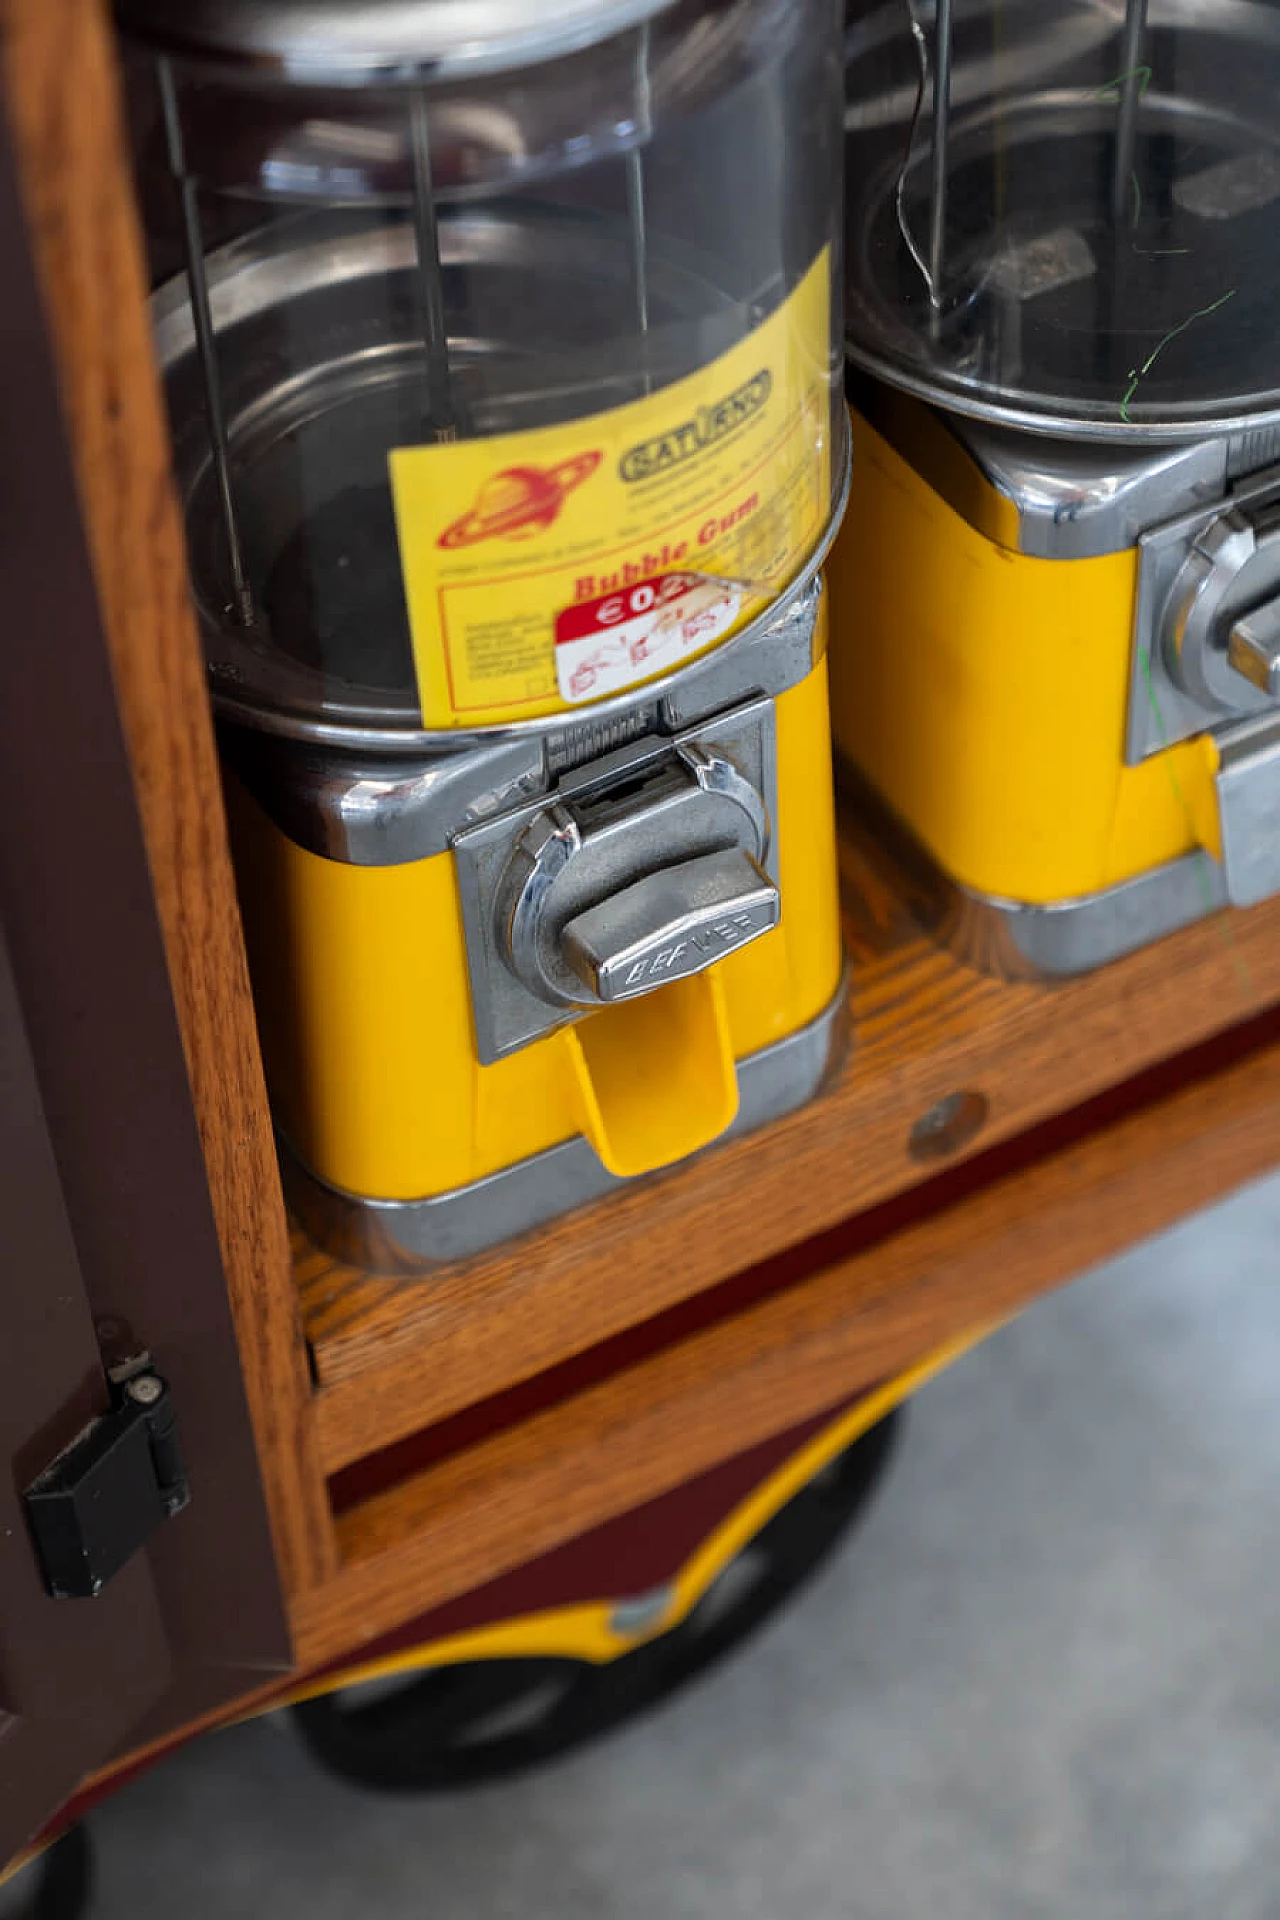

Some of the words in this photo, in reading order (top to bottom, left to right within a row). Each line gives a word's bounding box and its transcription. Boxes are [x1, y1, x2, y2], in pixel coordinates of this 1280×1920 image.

[625, 370, 771, 480] SATURNO
[575, 541, 690, 600] Bubble
[697, 491, 760, 546] Gum
